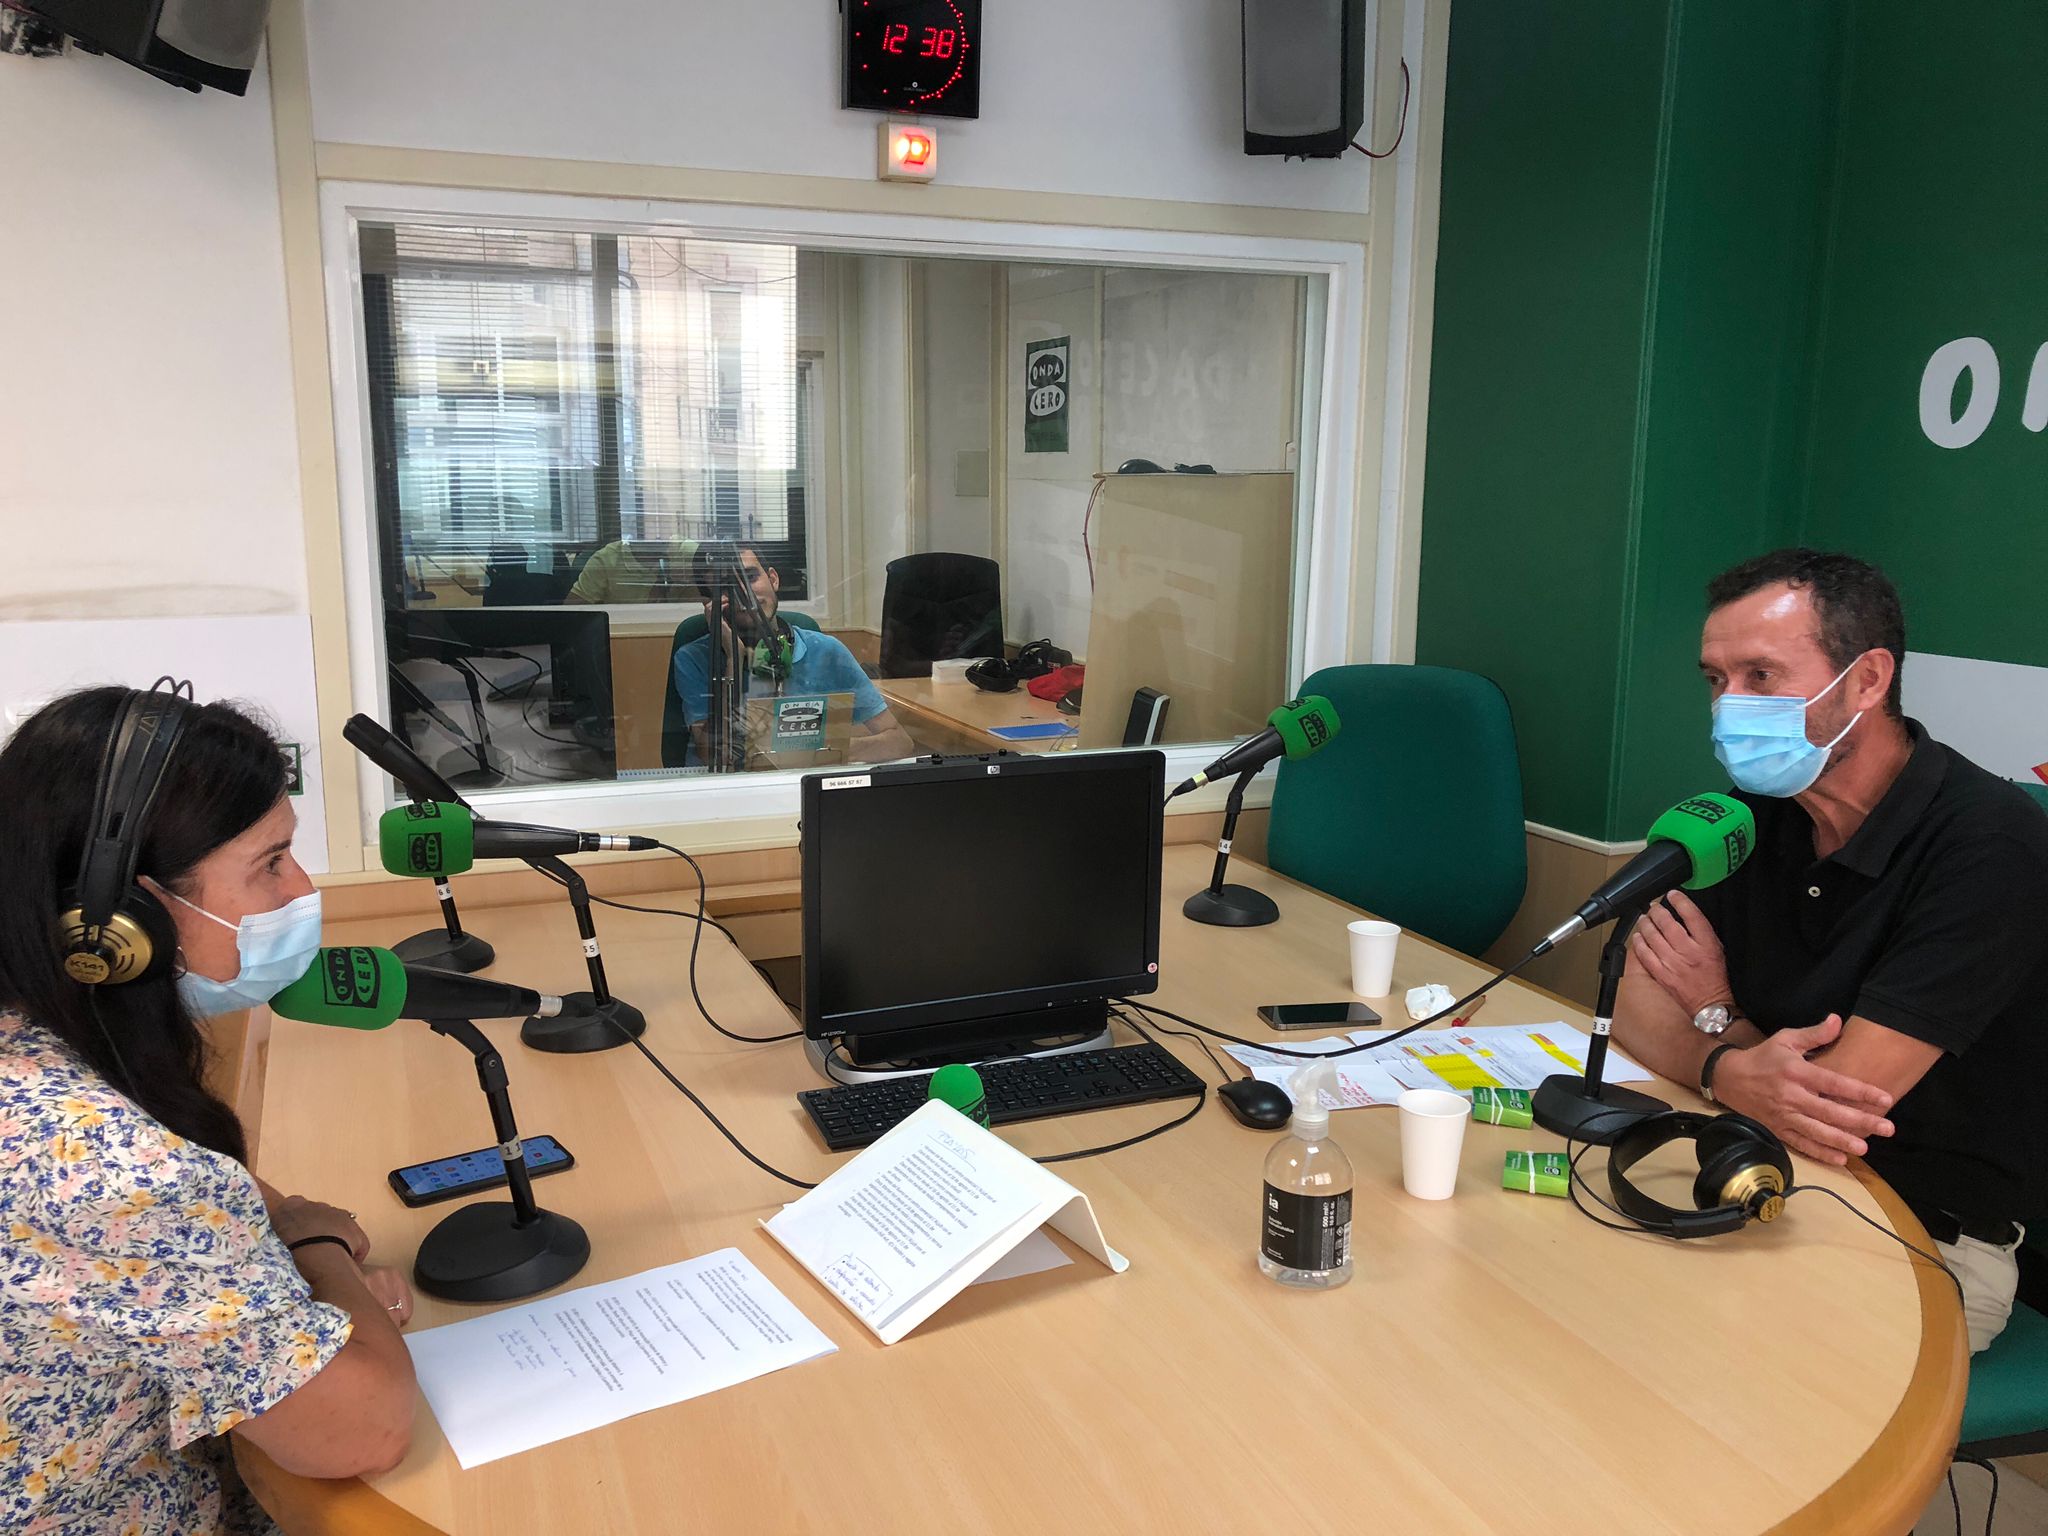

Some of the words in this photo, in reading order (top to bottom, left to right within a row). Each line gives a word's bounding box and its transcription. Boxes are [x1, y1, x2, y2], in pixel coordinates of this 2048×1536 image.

[882, 23, 909, 54] 12
[919, 27, 955, 58] 38
[1032, 362, 1061, 381] ONDA
[1034, 391, 1061, 410] CERO
[779, 722, 817, 731] CERO
[1599, 1023, 1606, 1032] 3
[1268, 1192, 1279, 1210] ia
